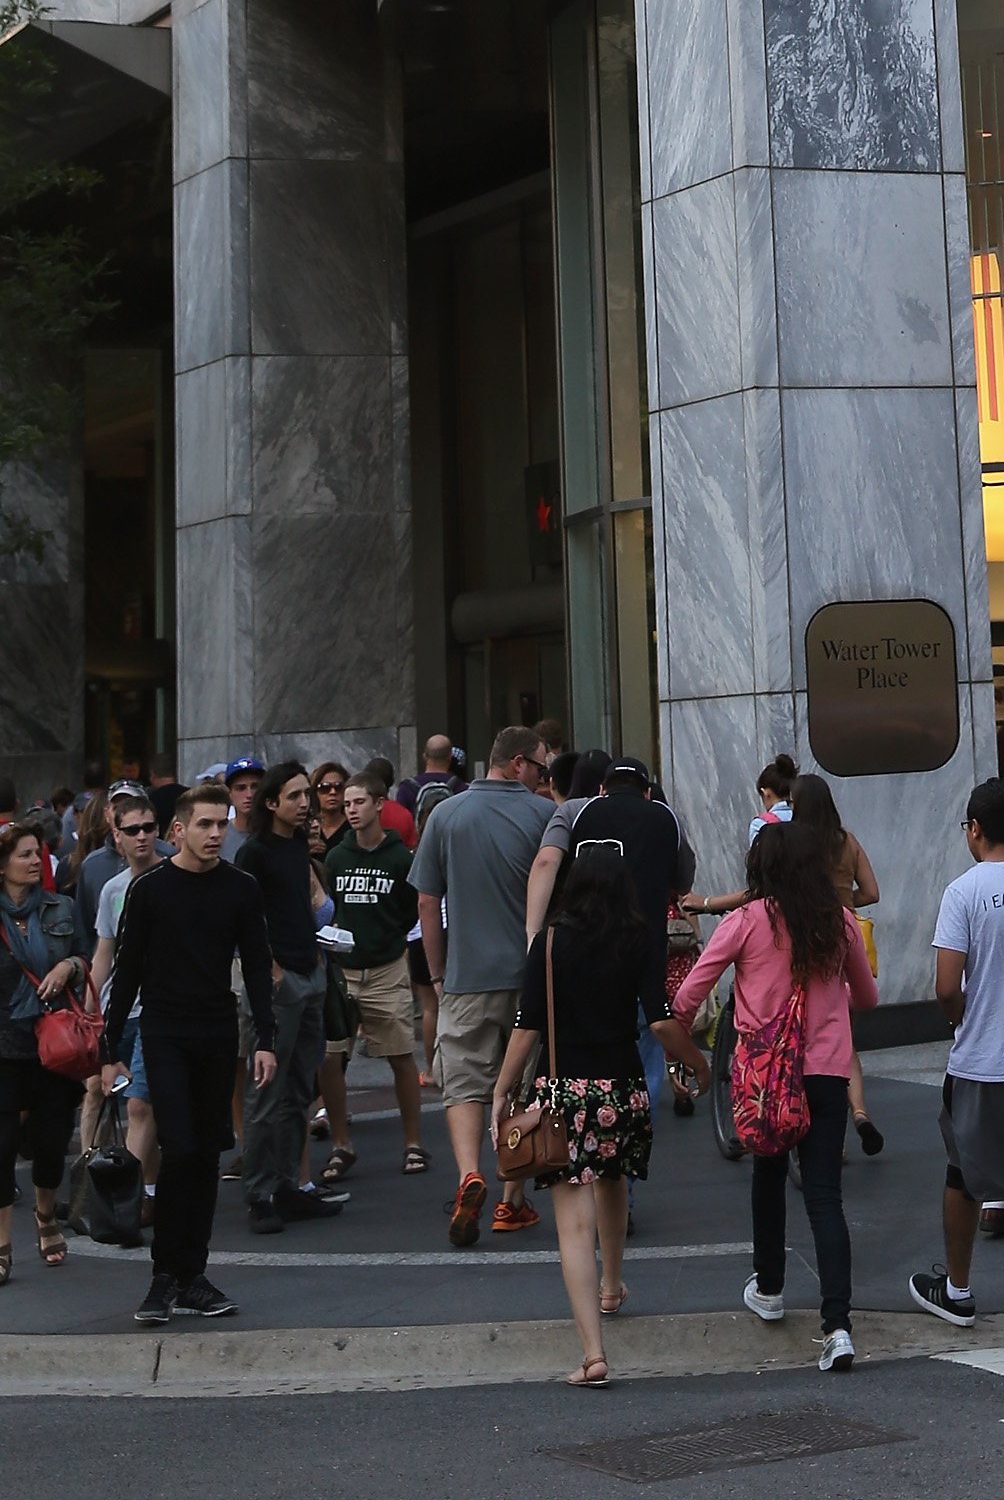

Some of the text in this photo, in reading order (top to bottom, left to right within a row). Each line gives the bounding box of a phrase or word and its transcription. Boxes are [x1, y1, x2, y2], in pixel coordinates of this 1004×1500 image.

[821, 638, 941, 661] Water Tower
[857, 667, 909, 689] Place
[336, 876, 395, 894] DUBLIN
[982, 899, 988, 911] I
